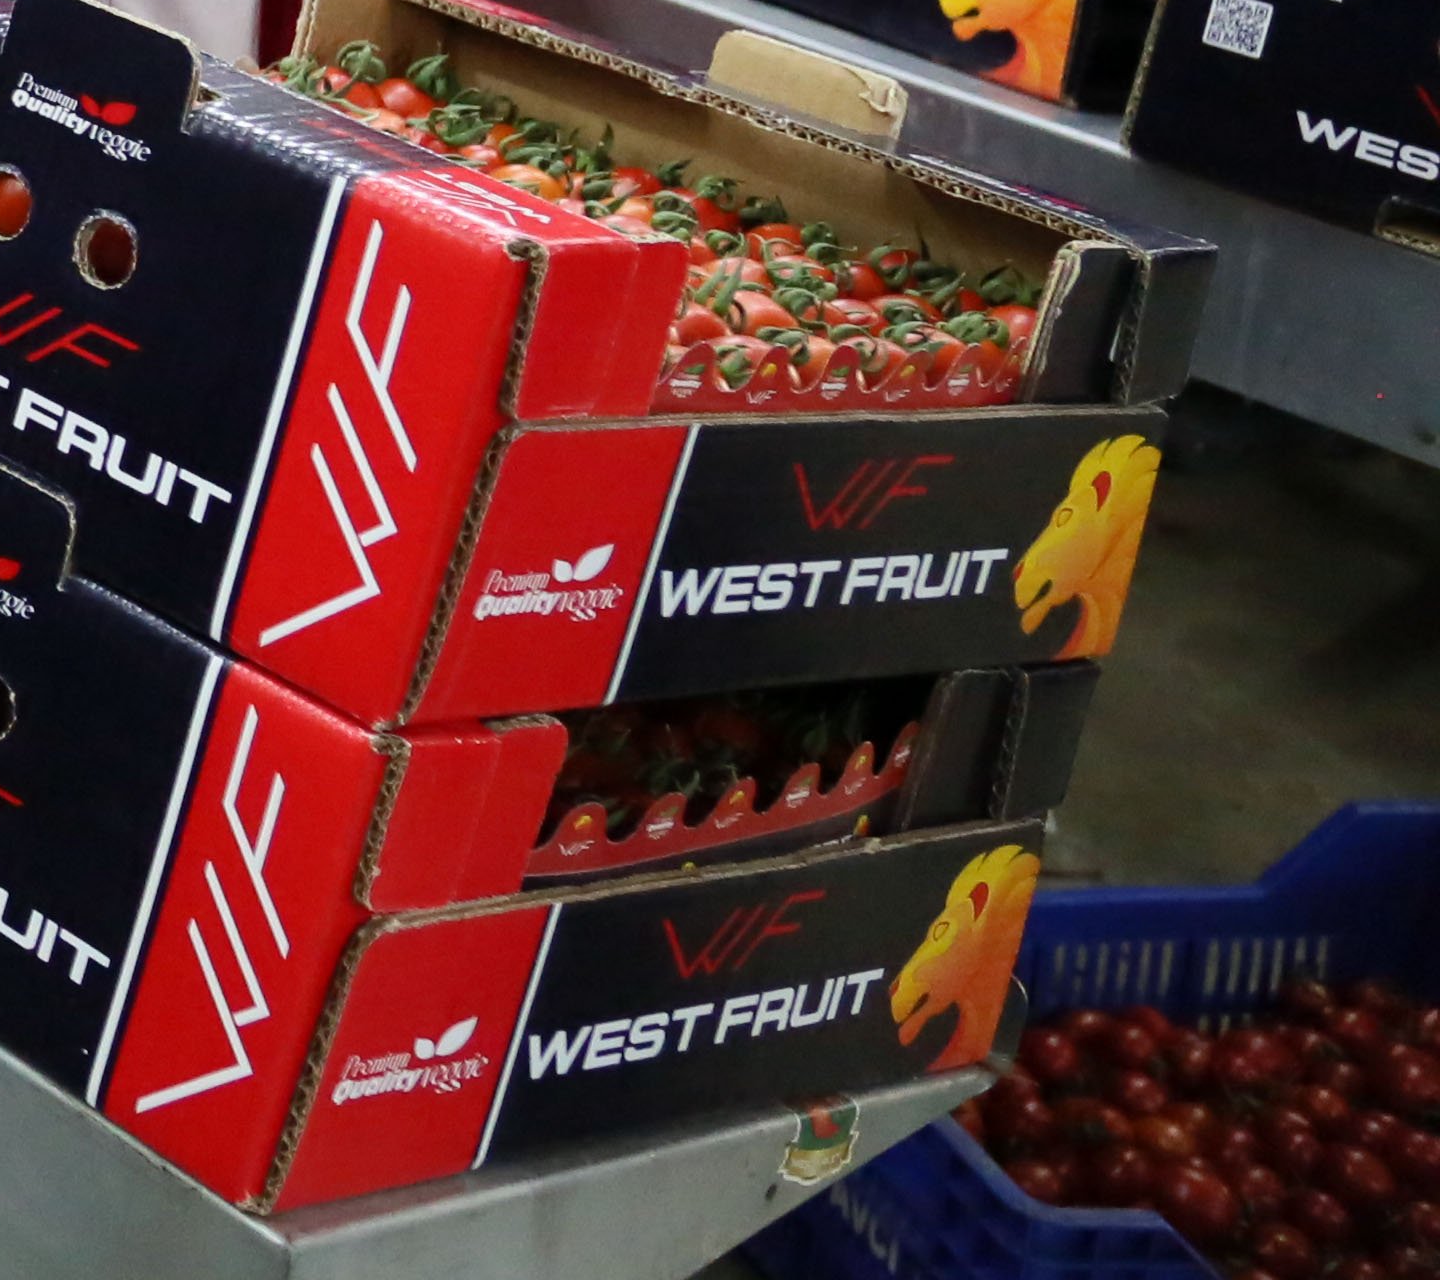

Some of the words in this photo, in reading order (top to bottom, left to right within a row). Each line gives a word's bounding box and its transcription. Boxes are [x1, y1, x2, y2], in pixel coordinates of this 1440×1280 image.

[11, 89, 91, 137] Quality
[88, 122, 152, 162] veggie
[17, 71, 79, 111] Premium
[1295, 111, 1440, 181] WES
[12, 385, 233, 526] FRUIT
[260, 219, 420, 647] WF
[793, 454, 956, 533] WF
[474, 586, 558, 622] Quality
[657, 558, 845, 620] WEST
[840, 547, 1009, 610] FRUIT
[136, 704, 290, 1114] WF
[661, 889, 826, 979] WF
[527, 1002, 714, 1082] WEST
[712, 966, 886, 1045] FRUIT
[331, 1069, 423, 1106] Quality
